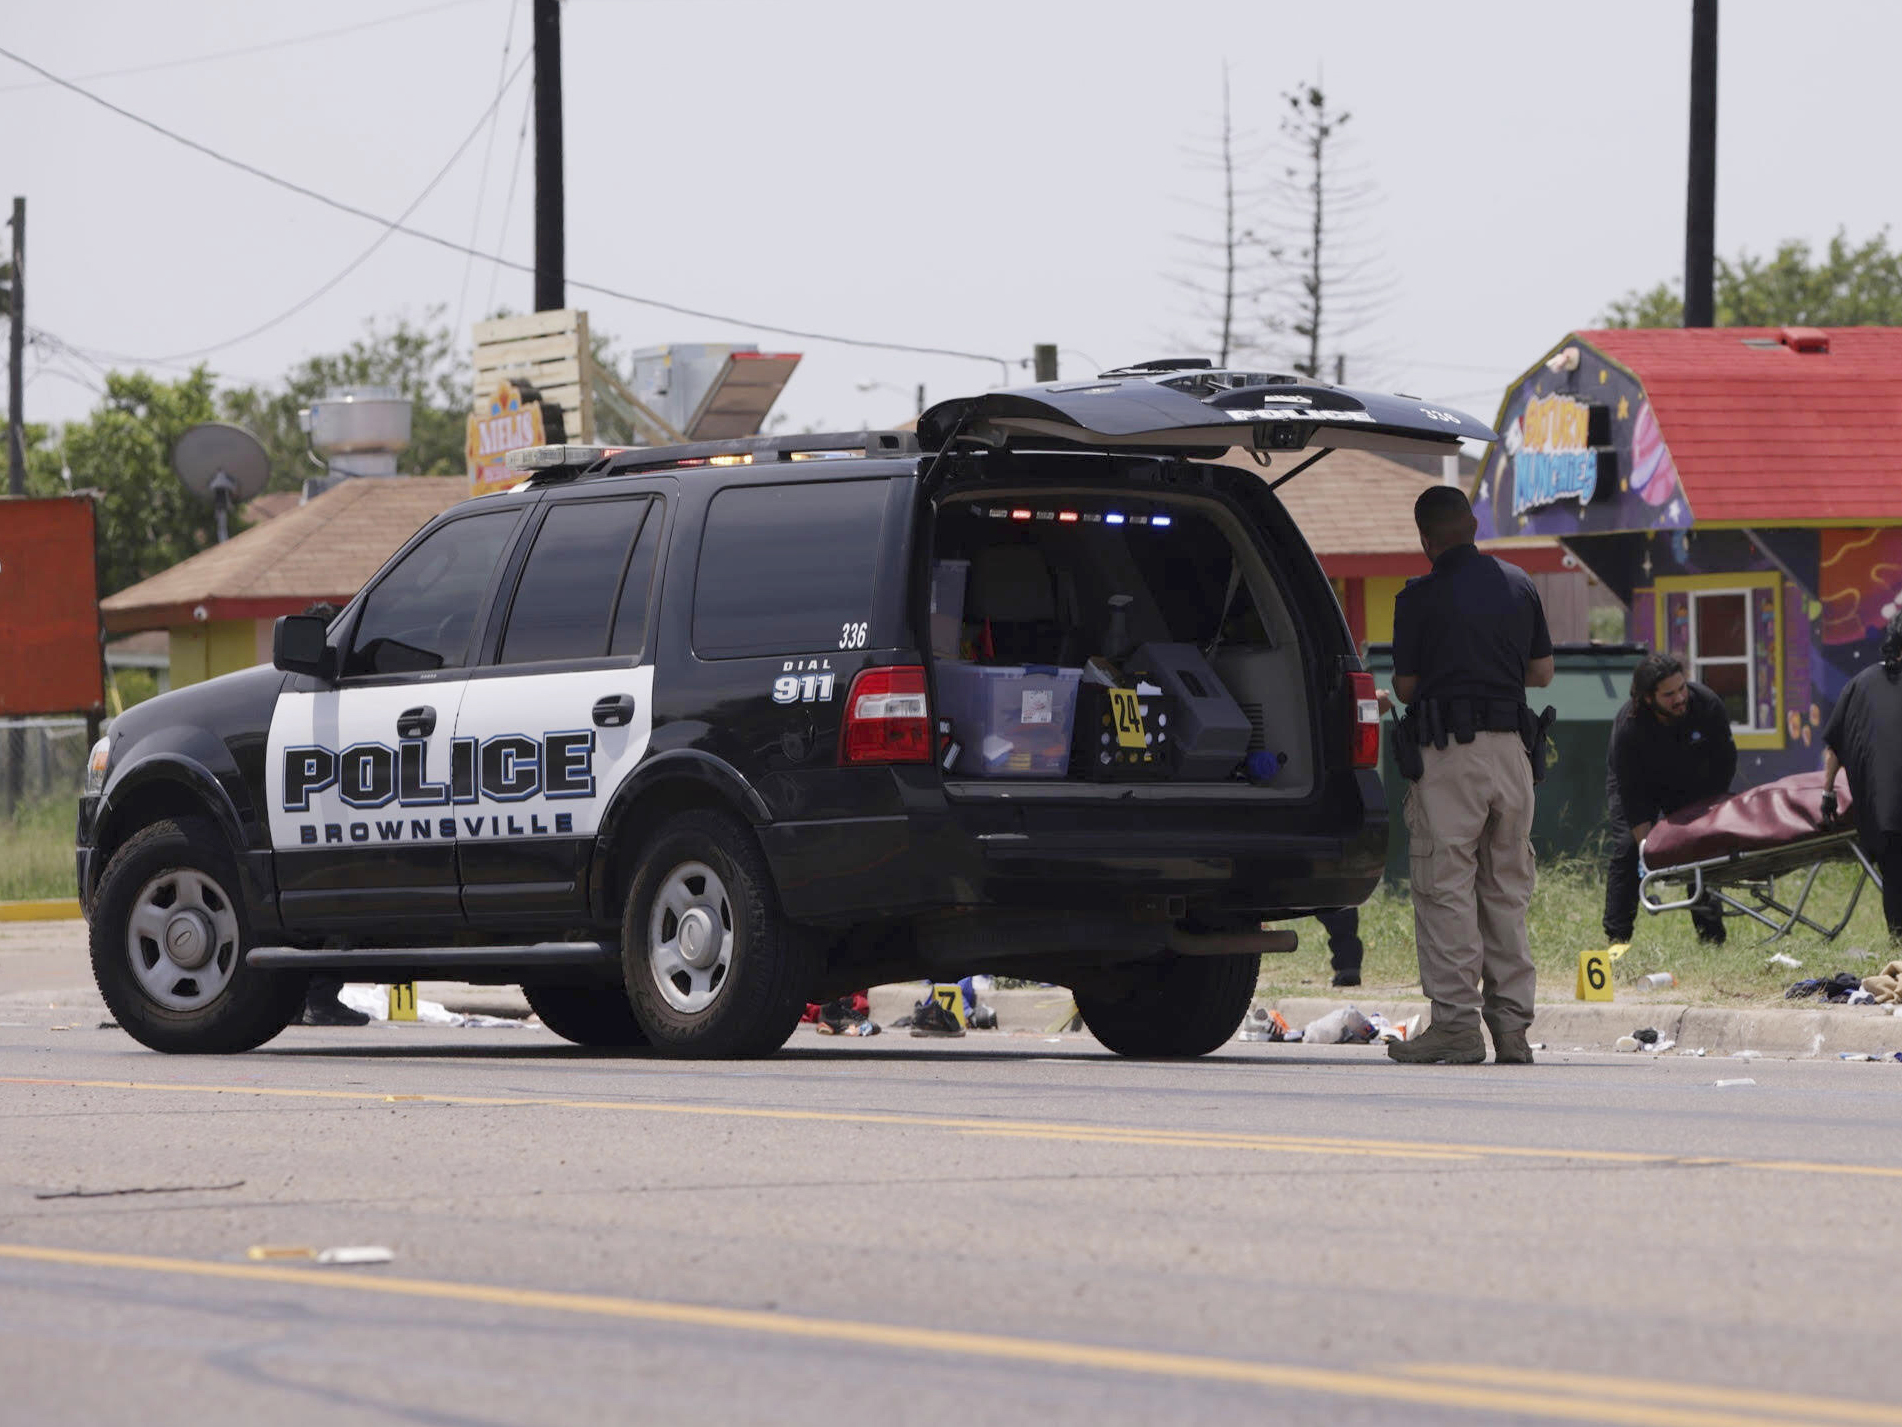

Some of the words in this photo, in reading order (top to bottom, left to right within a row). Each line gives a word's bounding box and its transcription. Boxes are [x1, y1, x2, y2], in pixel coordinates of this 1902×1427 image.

[1225, 408, 1377, 423] POLICE
[839, 622, 868, 649] 336
[782, 658, 831, 671] DIAL
[772, 672, 836, 704] 911
[1114, 693, 1141, 733] 24
[283, 729, 596, 813] POLICE
[300, 812, 573, 845] BROWNSVILLE
[1586, 957, 1606, 990] 6
[392, 983, 414, 1010] 11
[938, 991, 956, 1011] 7
